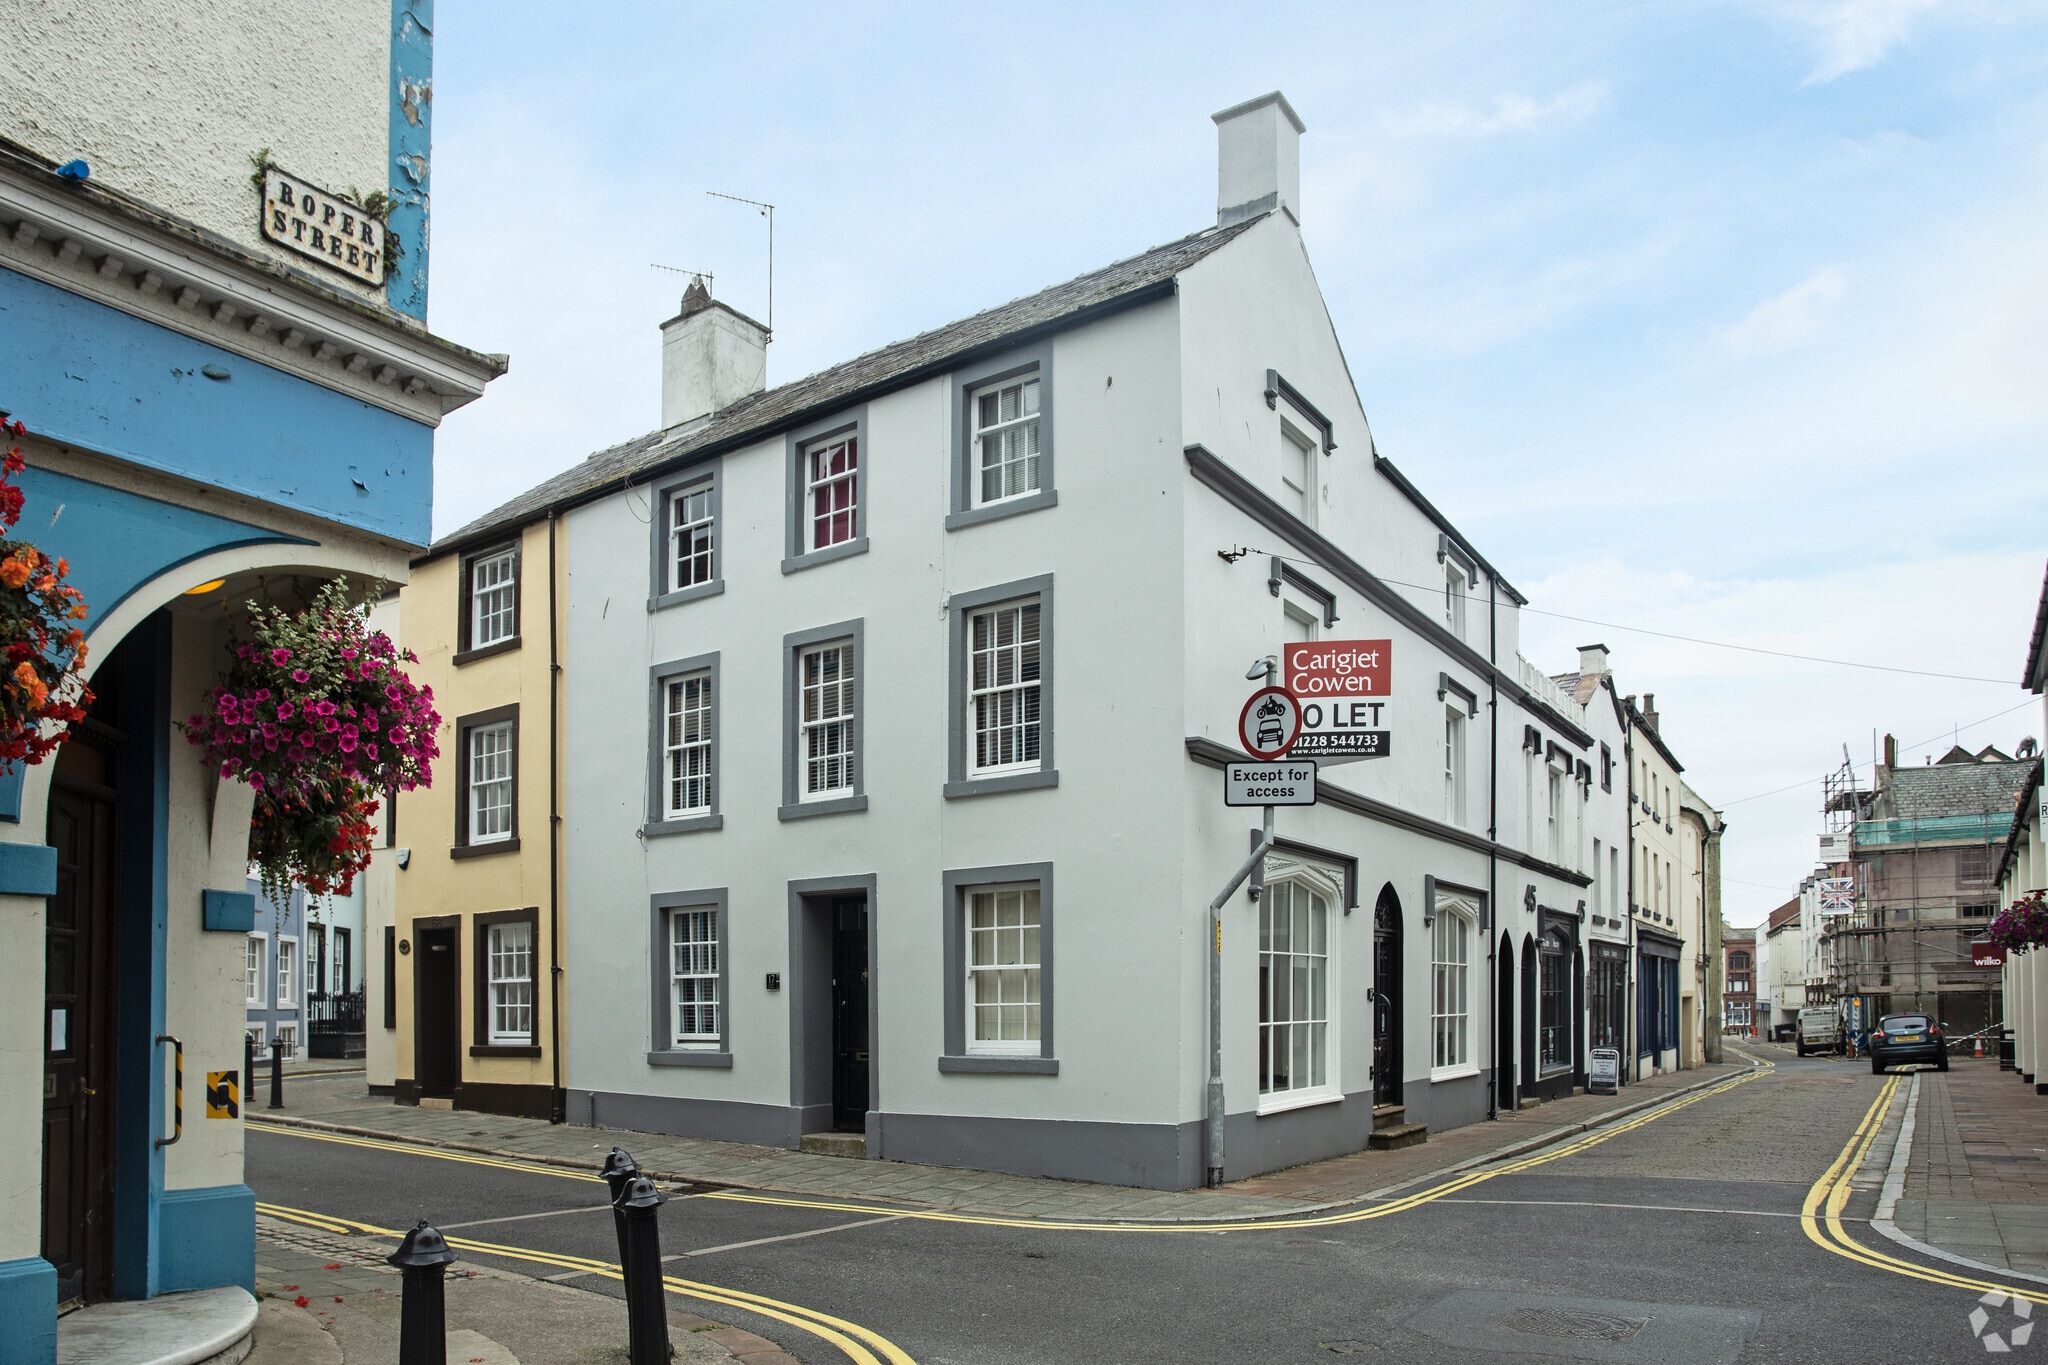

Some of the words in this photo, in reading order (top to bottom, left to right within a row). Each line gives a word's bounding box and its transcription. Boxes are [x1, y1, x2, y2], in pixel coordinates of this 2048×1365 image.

[280, 181, 375, 247] ROPER
[273, 210, 378, 274] STREET
[1292, 648, 1379, 675] Carigiet
[1292, 672, 1372, 693] Cowen
[1301, 703, 1323, 729] O
[1333, 702, 1385, 728] LET
[1291, 746, 1376, 755] www.carigietcowen.co.uk
[1330, 734, 1379, 746] 544733
[1233, 769, 1283, 783] Except
[1288, 769, 1309, 781] for
[1246, 786, 1295, 797] access
[1524, 884, 1536, 912] 45
[1576, 899, 1586, 924] 45
[1974, 956, 2001, 966] wilko
[768, 974, 775, 984] 17
